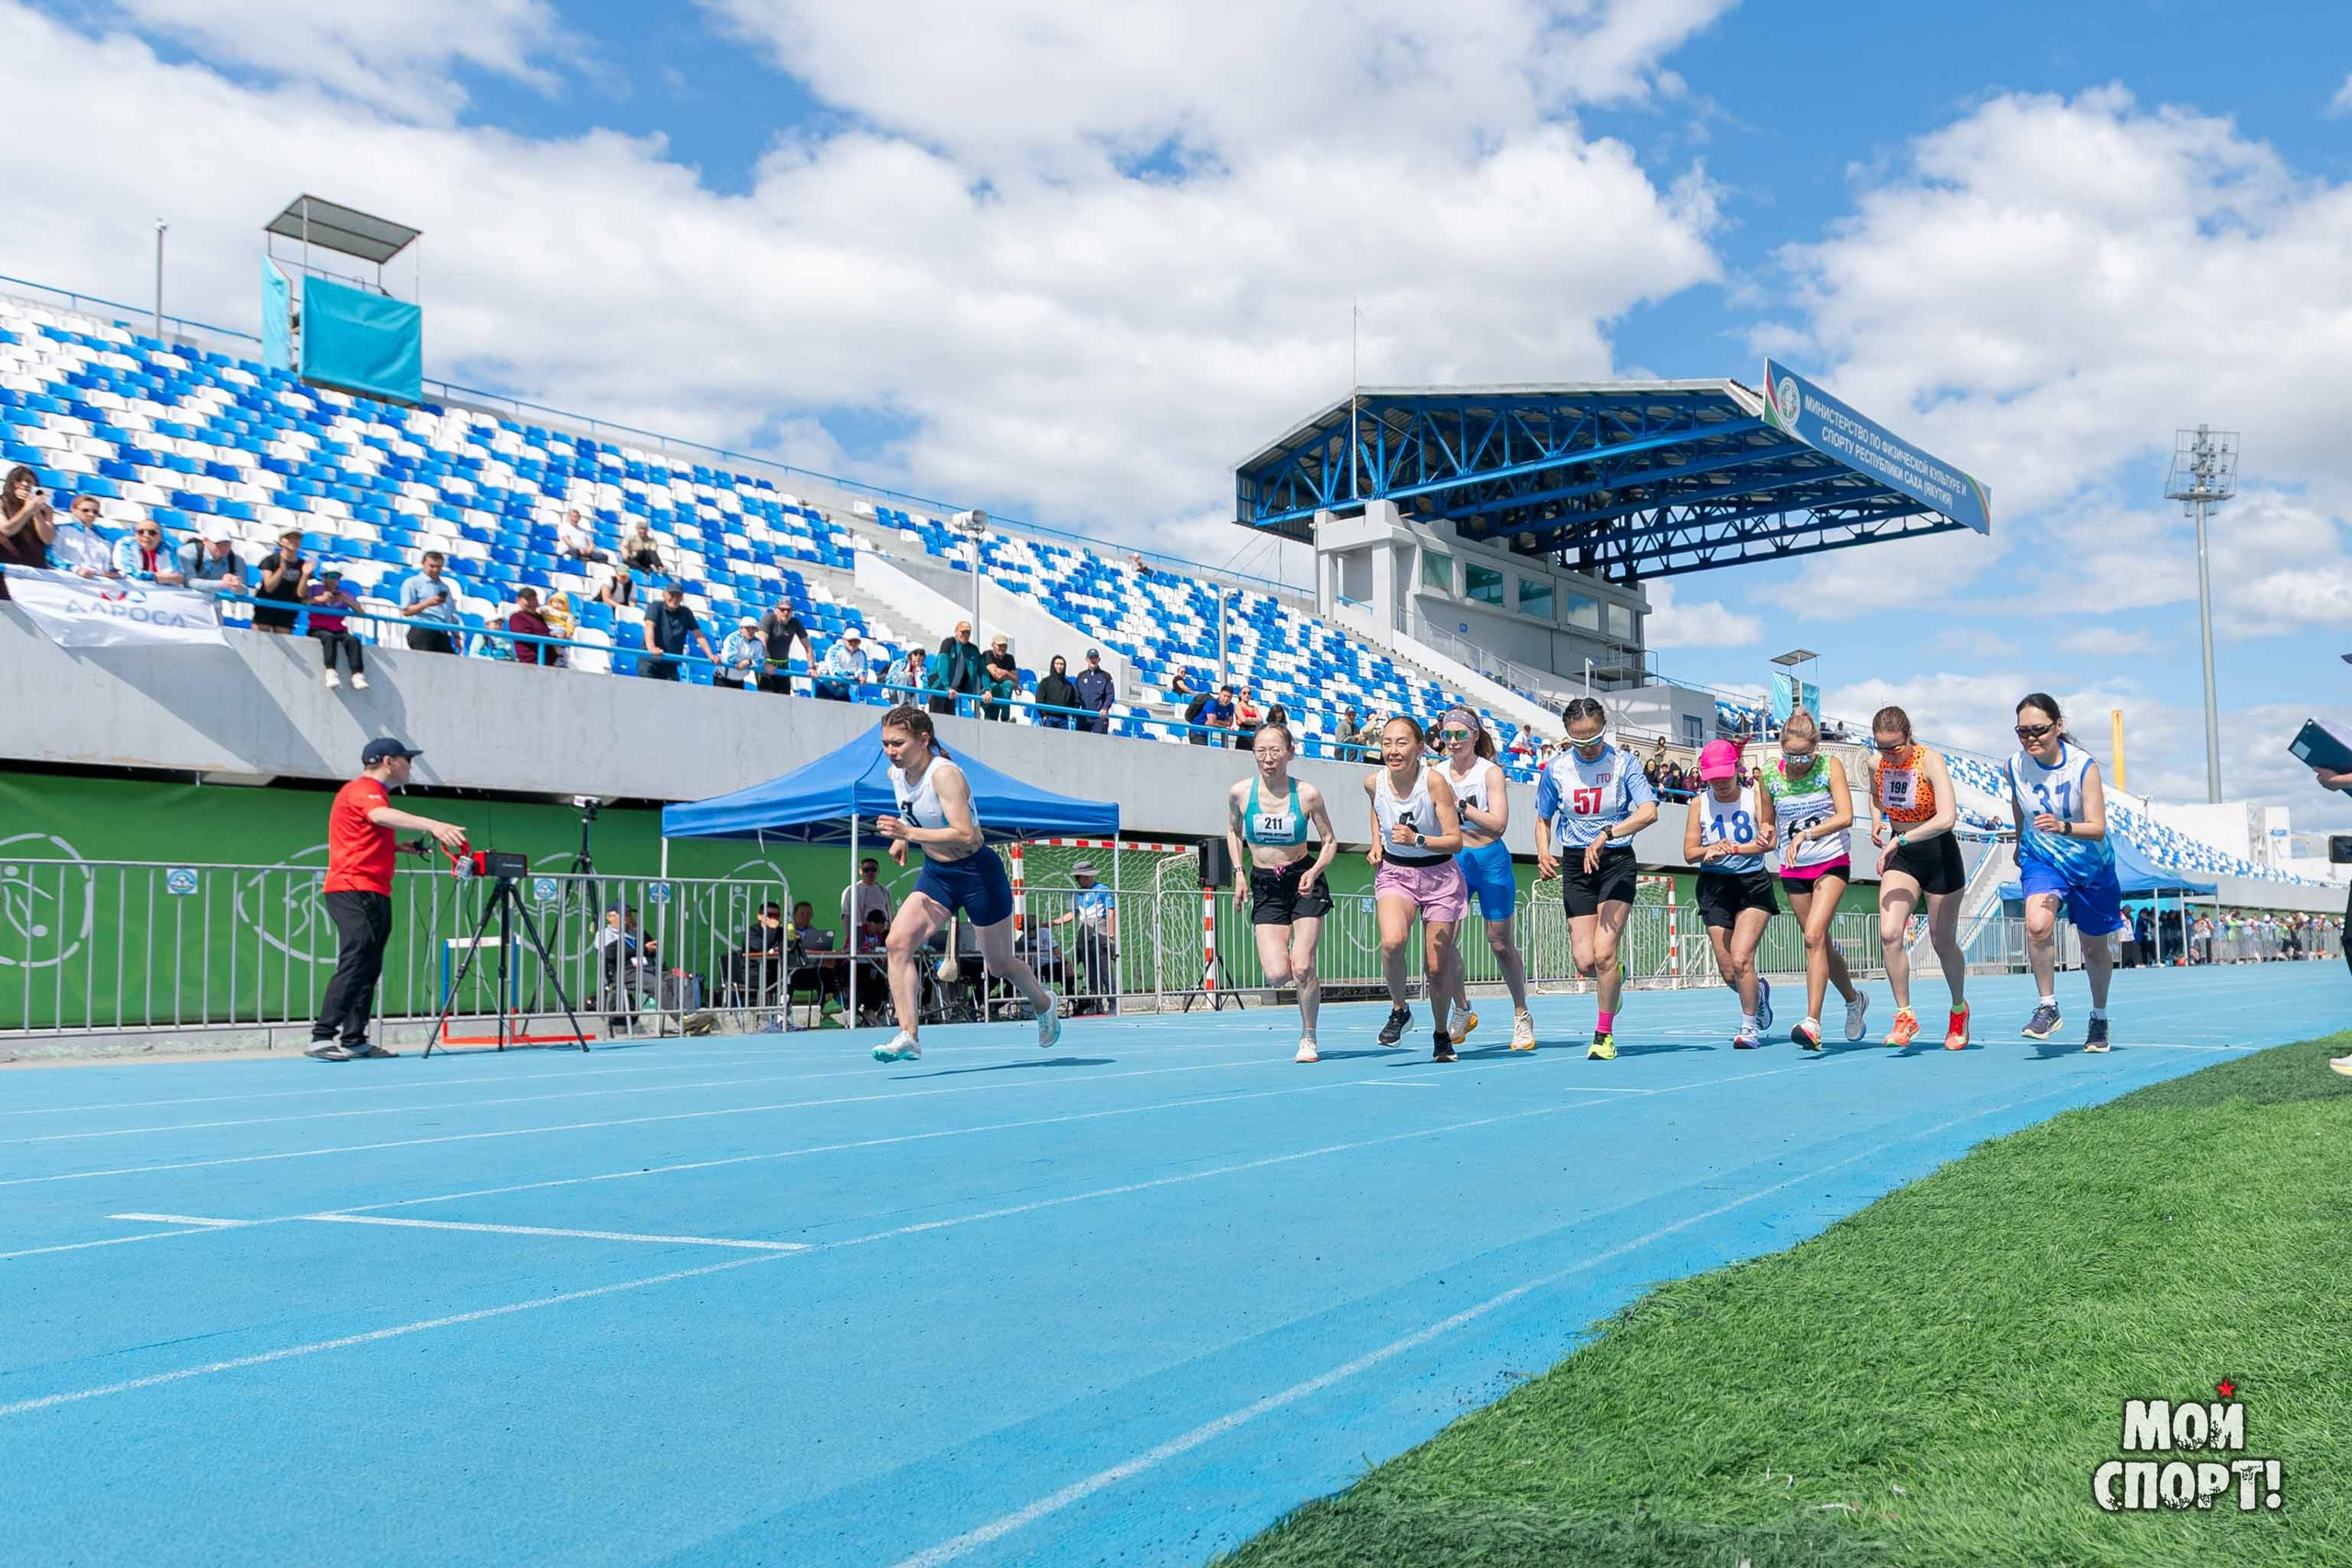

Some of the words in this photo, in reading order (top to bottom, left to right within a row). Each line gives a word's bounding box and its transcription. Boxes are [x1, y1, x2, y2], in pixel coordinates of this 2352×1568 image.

[1804, 394, 1869, 443] МИНИСТЕРСТВО
[1870, 433, 1881, 450] ПО
[1882, 441, 1929, 476] ФИЗИЧЕСКОЙ
[1929, 466, 1962, 493] КУЛЬТУРЕ
[1962, 483, 1967, 497] И
[1822, 426, 1854, 454] СПОРТУ
[1855, 444, 1903, 480] РЕСПУБЛИКИ
[1904, 470, 1923, 491] САХА
[1923, 480, 1953, 510] (ЯКУТИЯ)
[1574, 787, 1602, 815] 57
[1890, 781, 1908, 795] 198
[2032, 780, 2072, 819] 37
[1264, 817, 1283, 829] 211
[1711, 810, 1753, 843] 18
